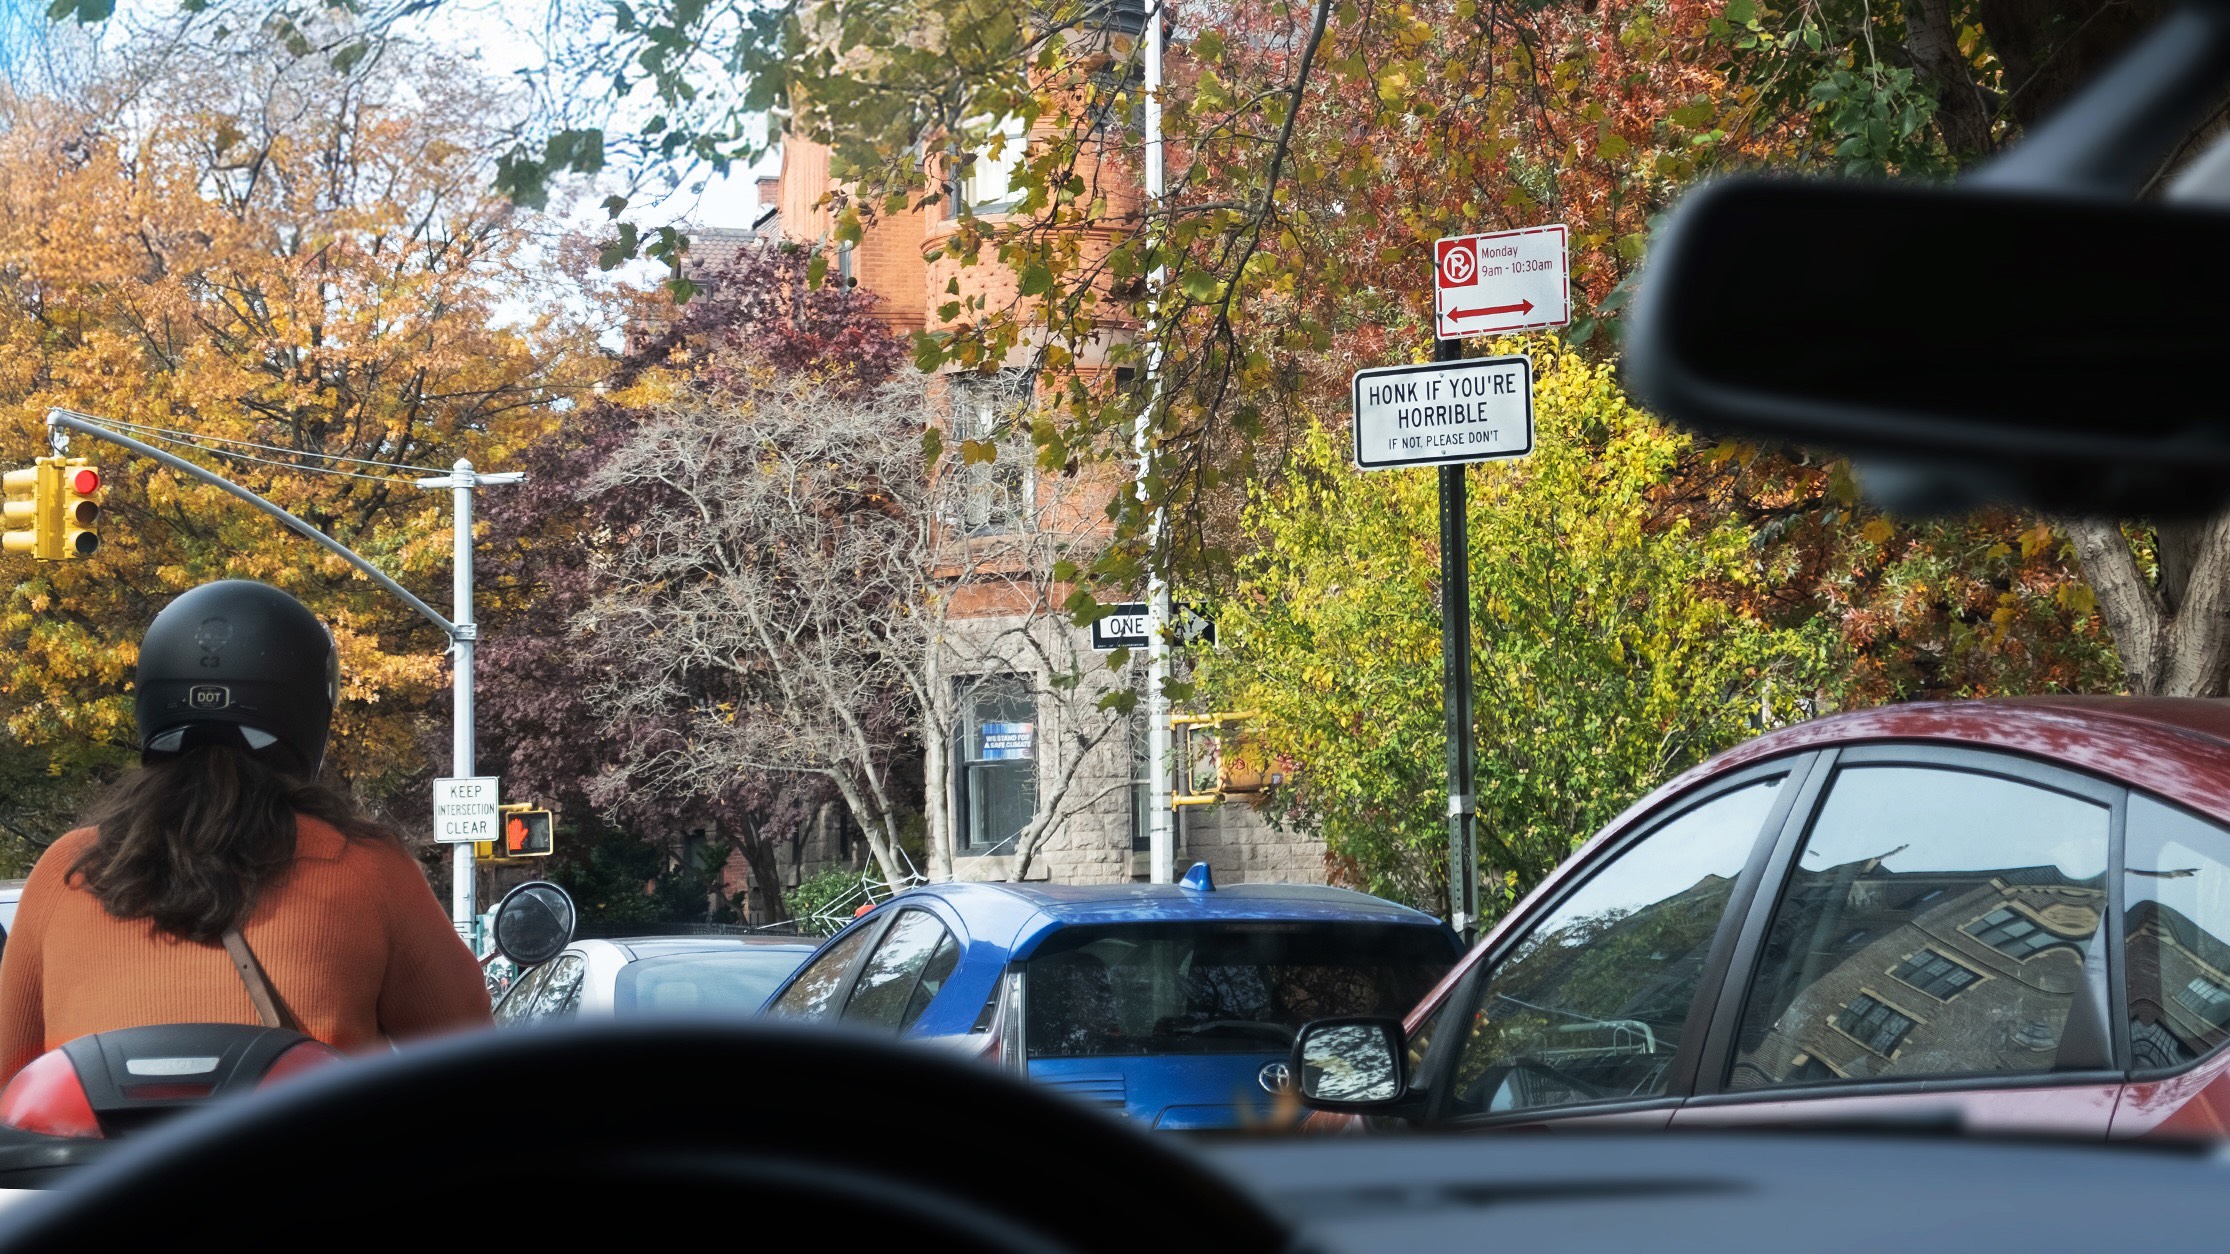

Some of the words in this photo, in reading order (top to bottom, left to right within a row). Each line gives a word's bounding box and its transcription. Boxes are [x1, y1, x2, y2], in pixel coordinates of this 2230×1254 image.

[1481, 245, 1518, 259] Monday
[1482, 265, 1502, 277] 9am
[1511, 260, 1553, 274] 10:30am
[1369, 382, 1418, 406] HONK
[1426, 380, 1442, 401] IF
[1450, 373, 1516, 399] YOU'RE
[1398, 401, 1488, 429] HORRIBLE
[1388, 438, 1398, 450] IF
[1426, 432, 1465, 447] PLEASE
[1468, 430, 1498, 444] DON'T
[1110, 617, 1144, 635] ONE
[197, 692, 221, 703] DOT
[990, 741, 1005, 749] SAFE
[1005, 740, 1031, 748] CLIMATE
[997, 734, 1017, 742] STAND
[450, 785, 482, 798] KEEP
[437, 803, 495, 816] INTERSECTION
[446, 820, 487, 835] CLEAR
